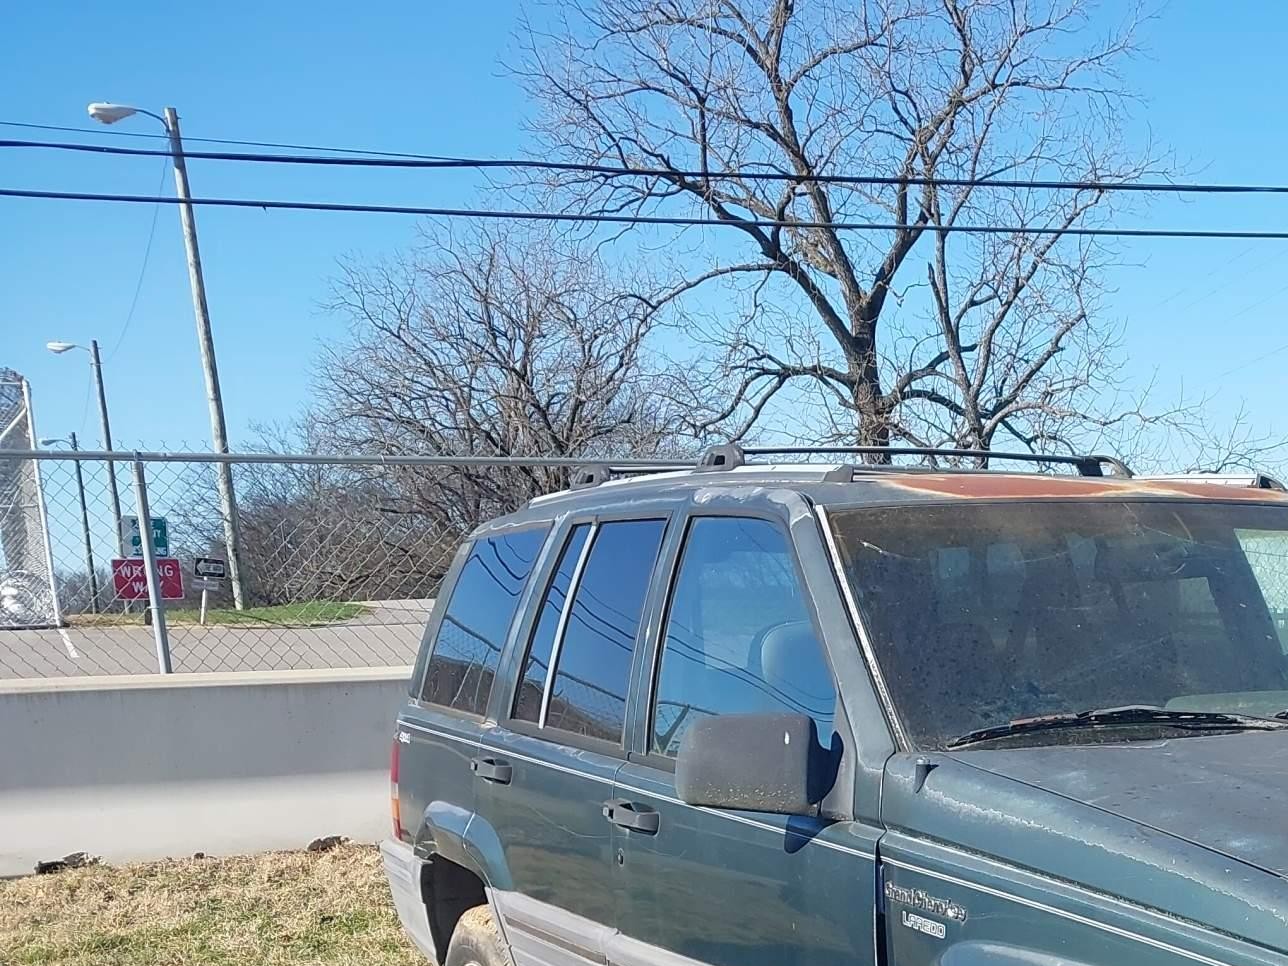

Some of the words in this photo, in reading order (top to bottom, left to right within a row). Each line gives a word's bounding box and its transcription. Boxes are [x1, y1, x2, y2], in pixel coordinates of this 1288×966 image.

[120, 564, 174, 577] WRNG
[885, 881, 915, 906] Grand
[902, 910, 946, 939] LAREDO
